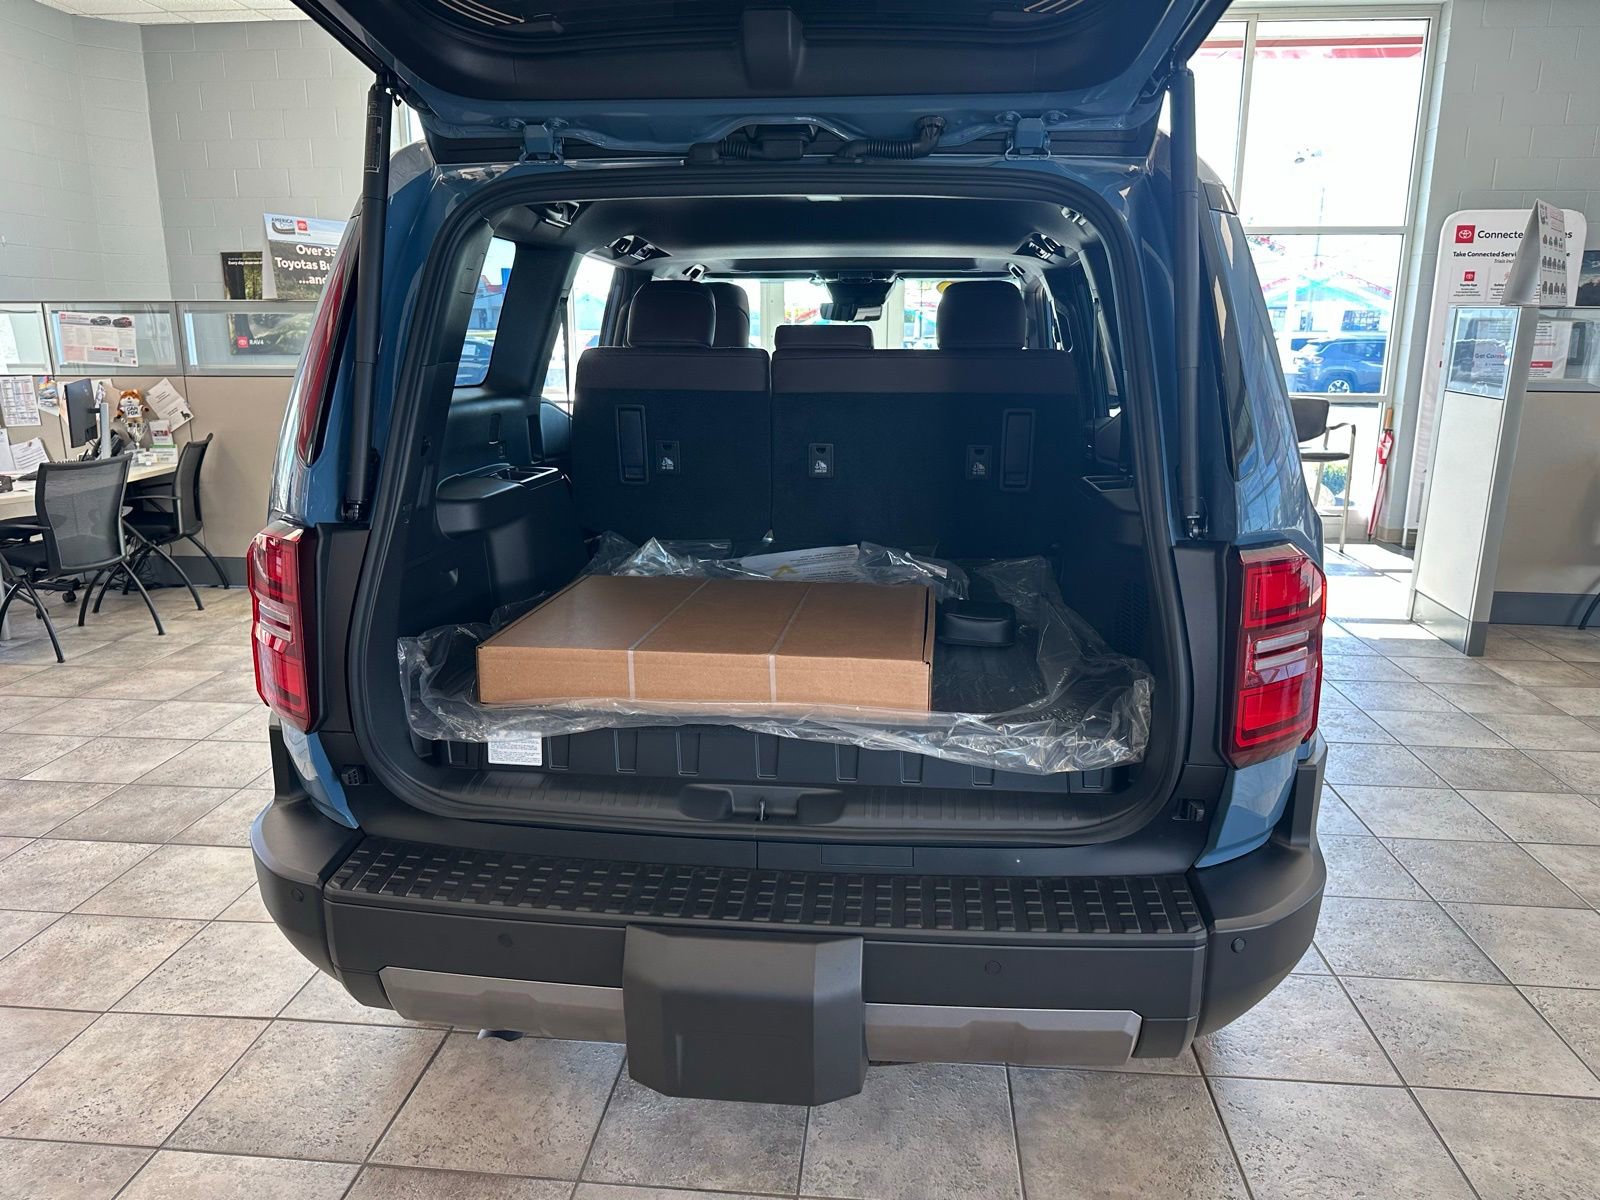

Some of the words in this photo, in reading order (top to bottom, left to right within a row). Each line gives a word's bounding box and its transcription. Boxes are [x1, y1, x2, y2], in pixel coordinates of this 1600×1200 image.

[1477, 230, 1524, 239] Connecte
[296, 244, 322, 257] Over
[275, 257, 318, 271] Toyotas
